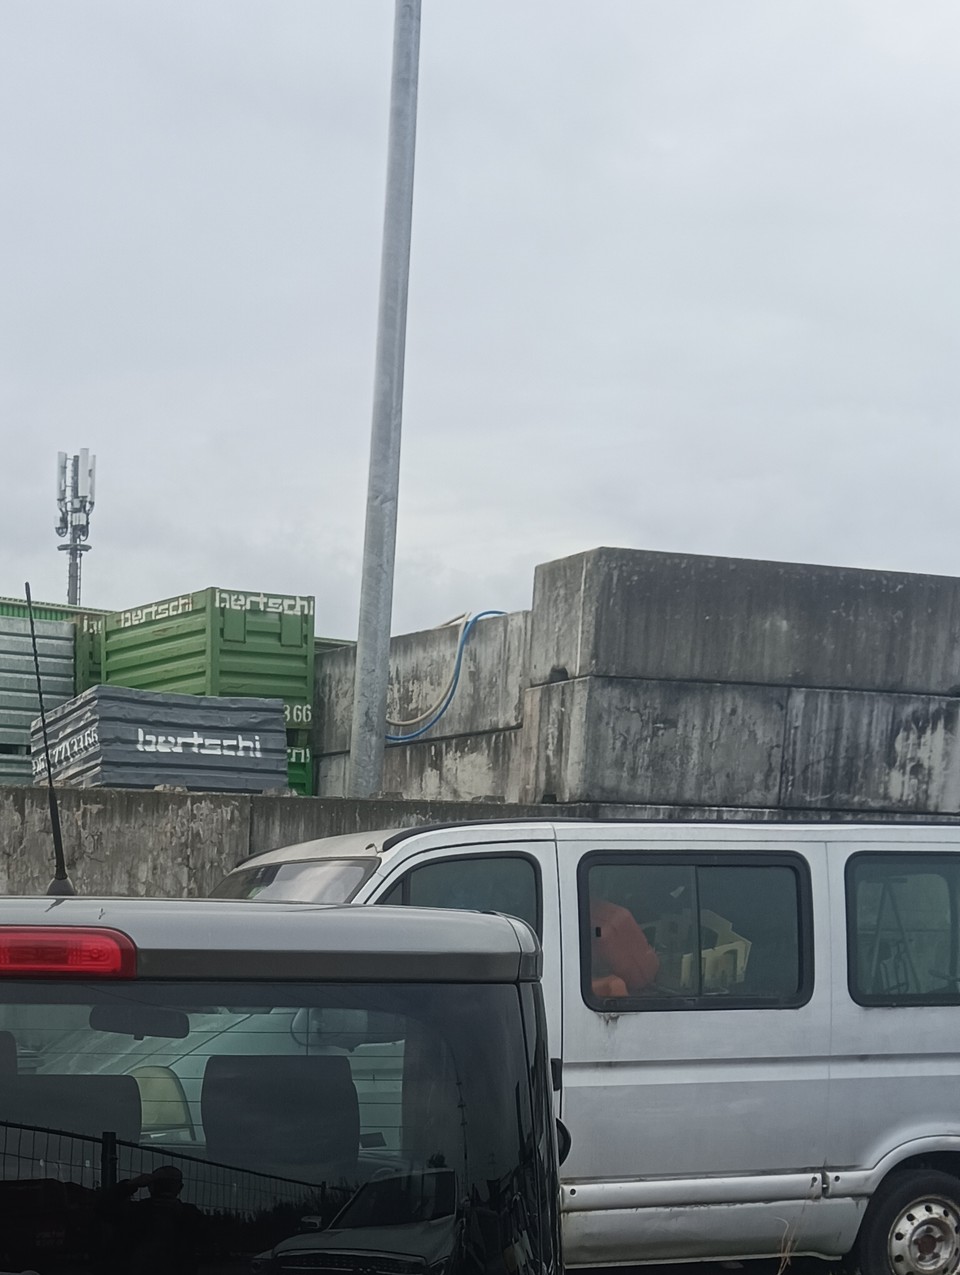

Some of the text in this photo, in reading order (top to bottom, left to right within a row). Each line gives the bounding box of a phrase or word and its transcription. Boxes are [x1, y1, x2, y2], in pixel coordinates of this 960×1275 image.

[121, 595, 193, 628] bertschi
[216, 588, 313, 616] bertschi
[136, 728, 262, 758] bertschi
